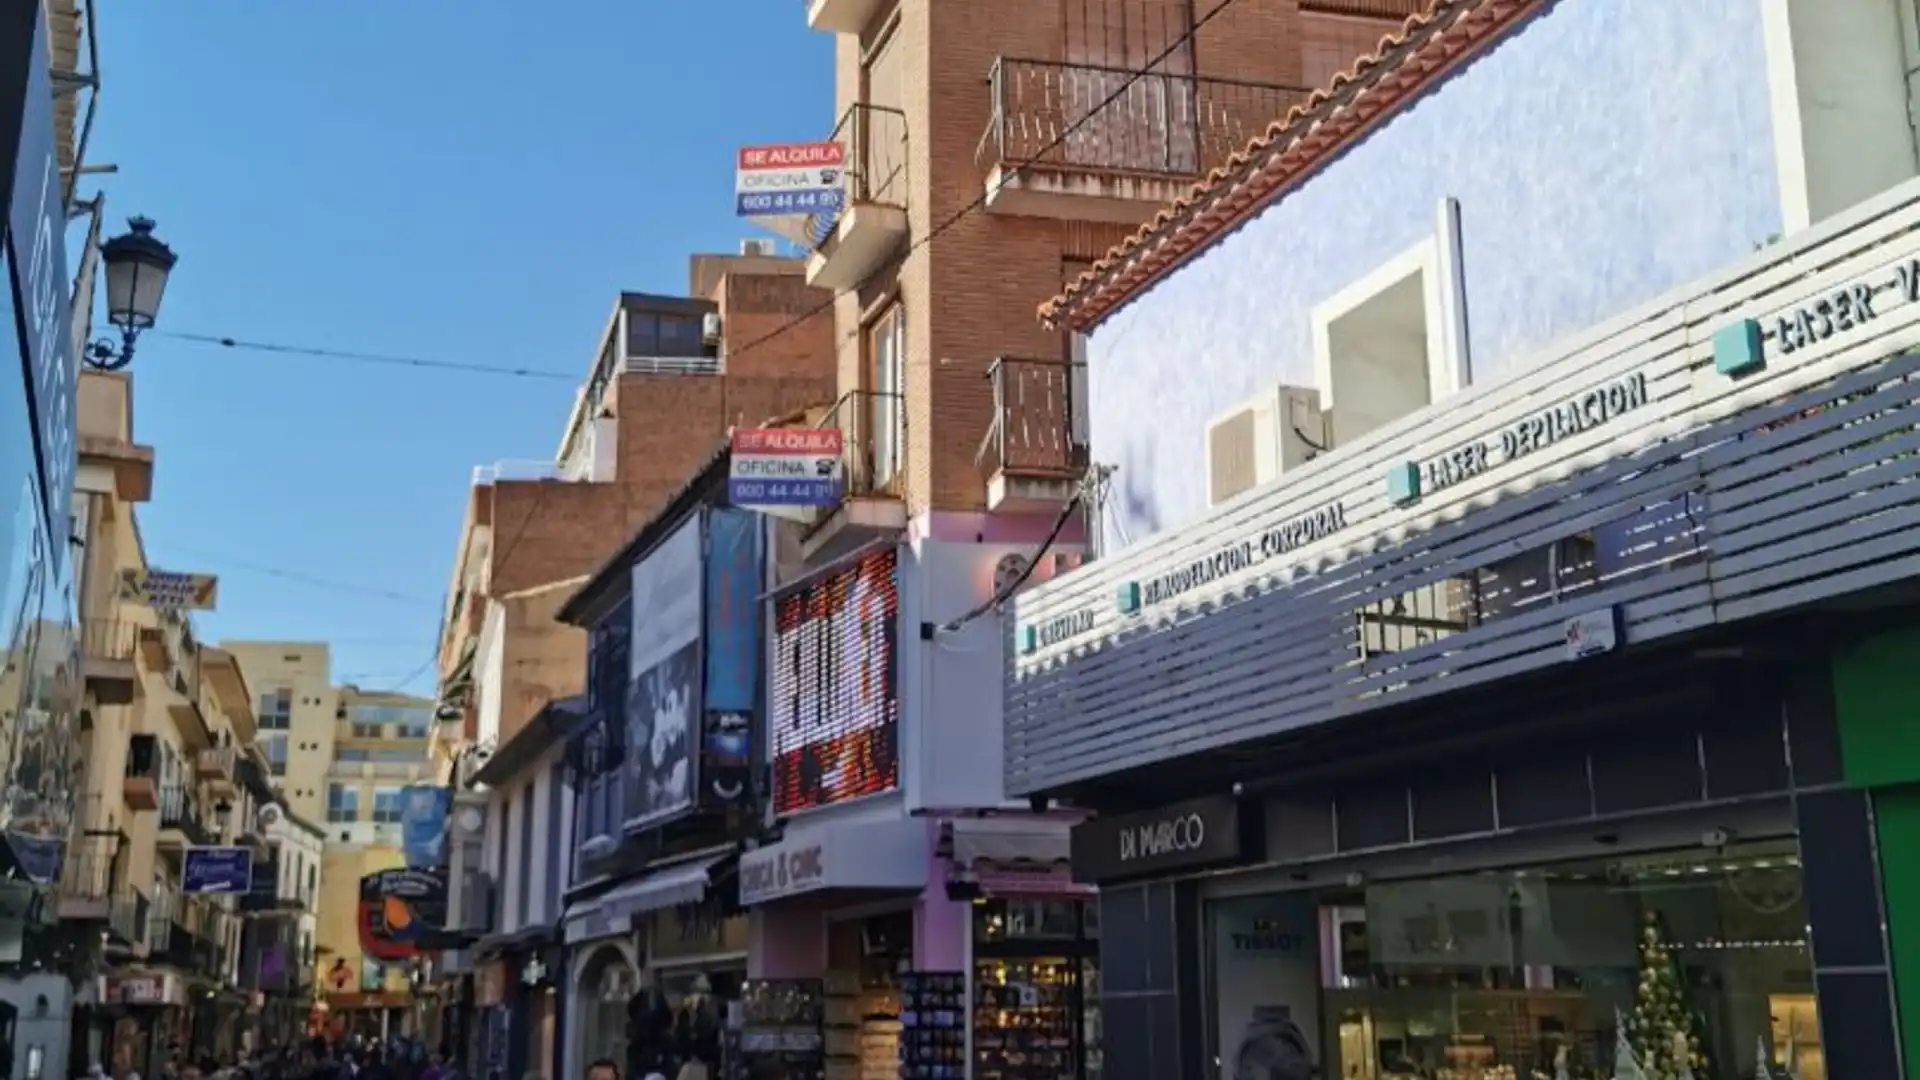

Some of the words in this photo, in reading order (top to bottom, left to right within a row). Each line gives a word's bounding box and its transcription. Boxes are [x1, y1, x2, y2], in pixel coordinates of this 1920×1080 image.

[744, 150, 765, 165] SE
[769, 147, 840, 164] ALQUILA
[744, 173, 810, 188] OFICINA
[775, 194, 793, 208] 44
[796, 193, 816, 207] 44
[1776, 282, 1875, 354] LASER
[1428, 442, 1490, 489] LASER
[1501, 372, 1649, 461] DEPILACION
[739, 434, 761, 449] SE
[765, 434, 836, 449] ALQUILA
[737, 460, 804, 475] OFICINA
[768, 484, 787, 497] 44
[791, 484, 810, 497] 44
[1144, 543, 1253, 606] REMODELACION
[1261, 501, 1348, 558] CORPORAL
[1120, 827, 1136, 861] DI
[1141, 812, 1204, 857] MARCO
[1231, 933, 1305, 951] TISSOT
